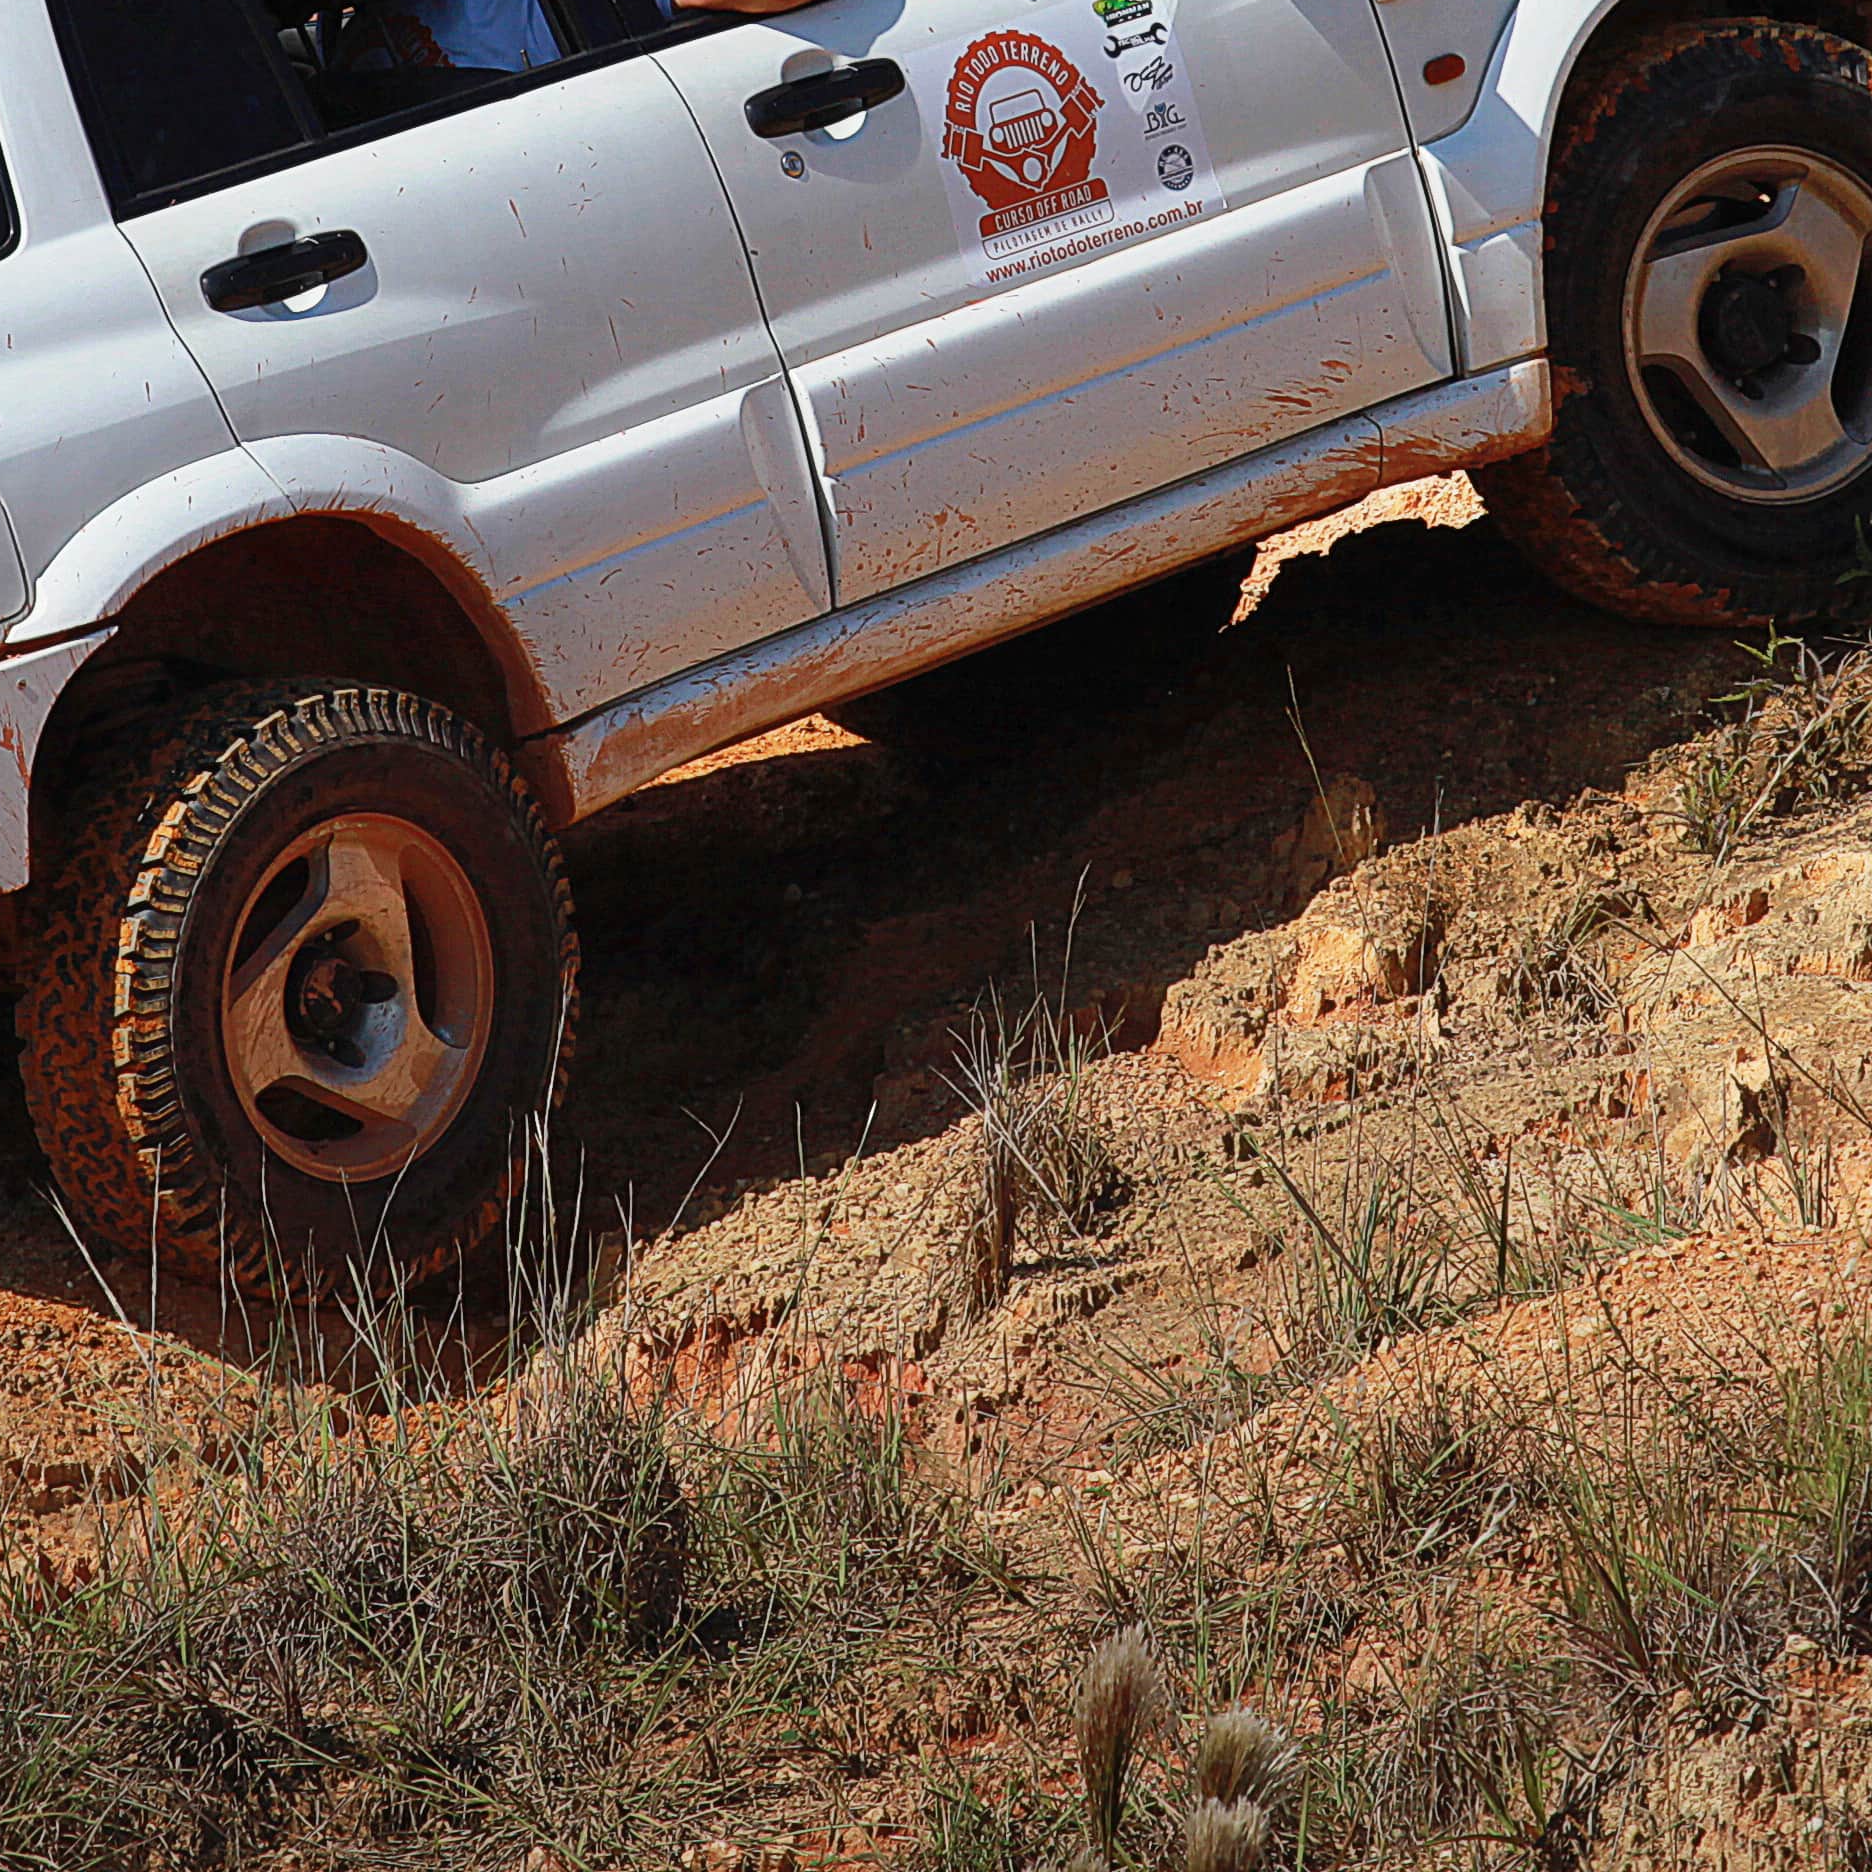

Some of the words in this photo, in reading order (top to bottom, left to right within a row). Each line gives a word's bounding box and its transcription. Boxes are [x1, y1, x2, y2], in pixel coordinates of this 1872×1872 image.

[964, 45, 1000, 81] TODO
[999, 40, 1069, 86] TERRENO
[955, 81, 975, 113] RIO
[994, 205, 1034, 231] CURSO
[1036, 196, 1058, 218] OFF
[1061, 185, 1092, 209] ROAD
[986, 200, 1203, 283] www.riotodoterreno.com.br
